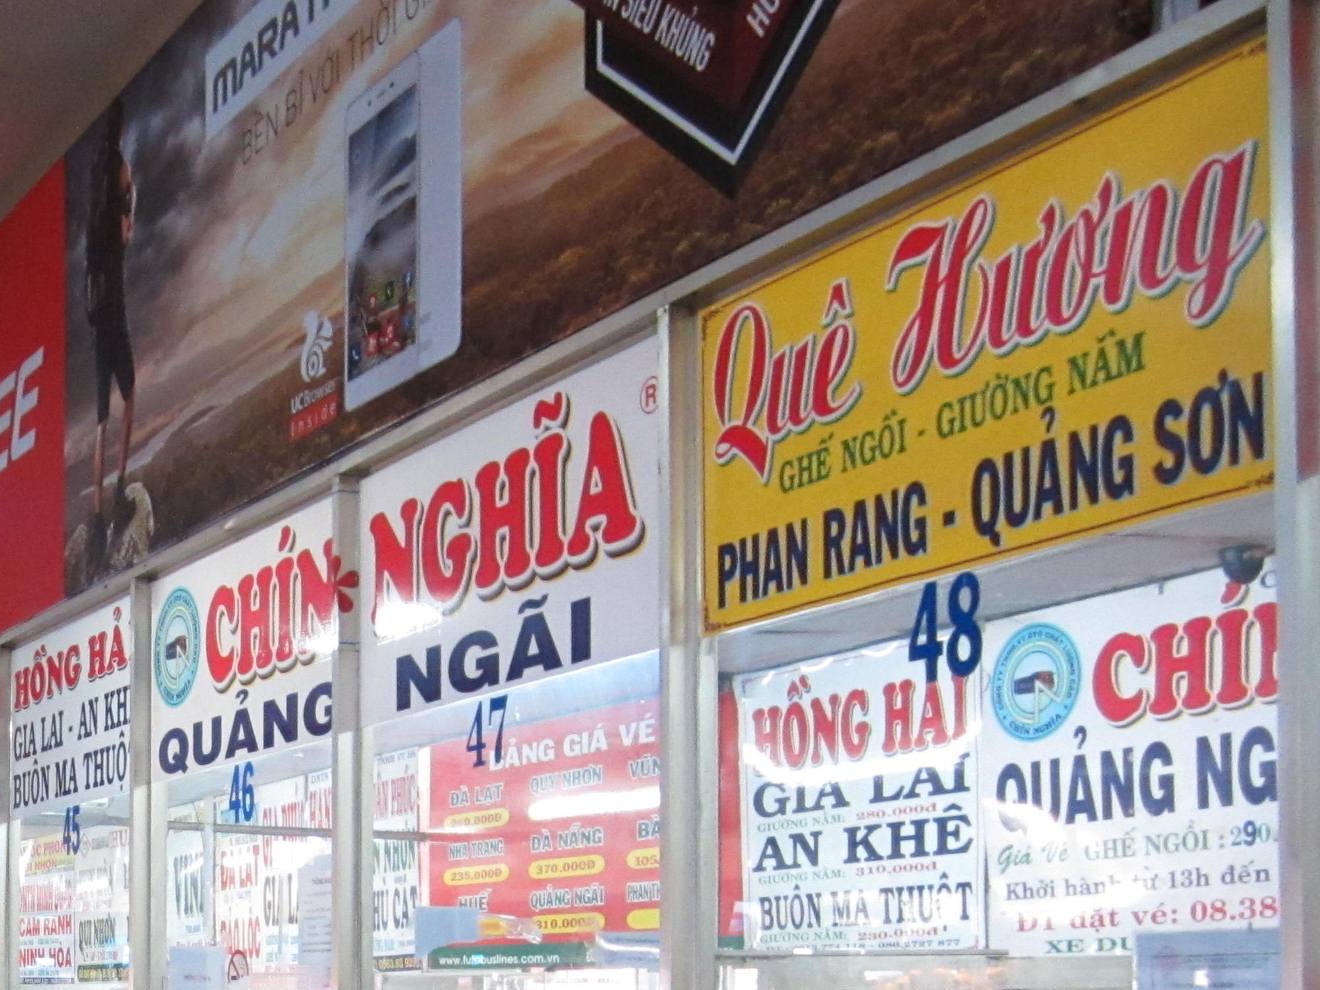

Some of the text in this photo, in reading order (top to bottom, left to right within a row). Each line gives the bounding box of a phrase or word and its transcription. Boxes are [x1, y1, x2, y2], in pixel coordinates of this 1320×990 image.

[654, 4, 716, 72] KHỦNG
[713, 138, 1264, 485] Quê Hương
[779, 430, 831, 494] GHẾ
[840, 408, 908, 475] NGỒI
[936, 366, 1055, 440] GIƯỜNG
[717, 517, 810, 610] PHAN
[822, 481, 928, 581] RANG
[971, 406, 1136, 549] QUẢNG
[1152, 368, 1266, 487] SƠN
[205, 525, 338, 690] CHÍN
[369, 392, 645, 638] NGHĨA
[908, 570, 980, 686] 48
[13, 643, 83, 713] HỒNG
[157, 593, 592, 775] QUẢNG NGÃI
[13, 719, 38, 763] GIA
[40, 710, 64, 754] LAI
[77, 696, 100, 741] AN
[103, 685, 131, 733] KH
[465, 694, 509, 769] 47
[562, 722, 608, 757] GIÁ
[618, 712, 656, 747] VÉ
[751, 673, 872, 771] HỒNG
[13, 730, 131, 810] BUÔN MA THUỘ
[228, 761, 255, 824] 46
[449, 784, 470, 808] ĐÀ
[529, 763, 603, 794] QUY NHƠN
[752, 751, 971, 819] GIA LAI
[996, 725, 1176, 834] QUẢNG
[62, 805, 81, 856] 45
[471, 838, 504, 859] TRANG
[530, 822, 603, 852] ĐÀ NẴNG
[752, 802, 974, 874] AN KHÊ
[997, 843, 1033, 874] Giá
[1144, 819, 1210, 856] NGỒI
[530, 882, 605, 910] QUẢNG NGÃI
[758, 883, 823, 933] BUÔN
[1167, 866, 1210, 889] 13h
[1220, 859, 1271, 885] đến
[43, 914, 72, 936] RANH
[1045, 937, 1085, 954] XE
[1132, 902, 1179, 926] vé:
